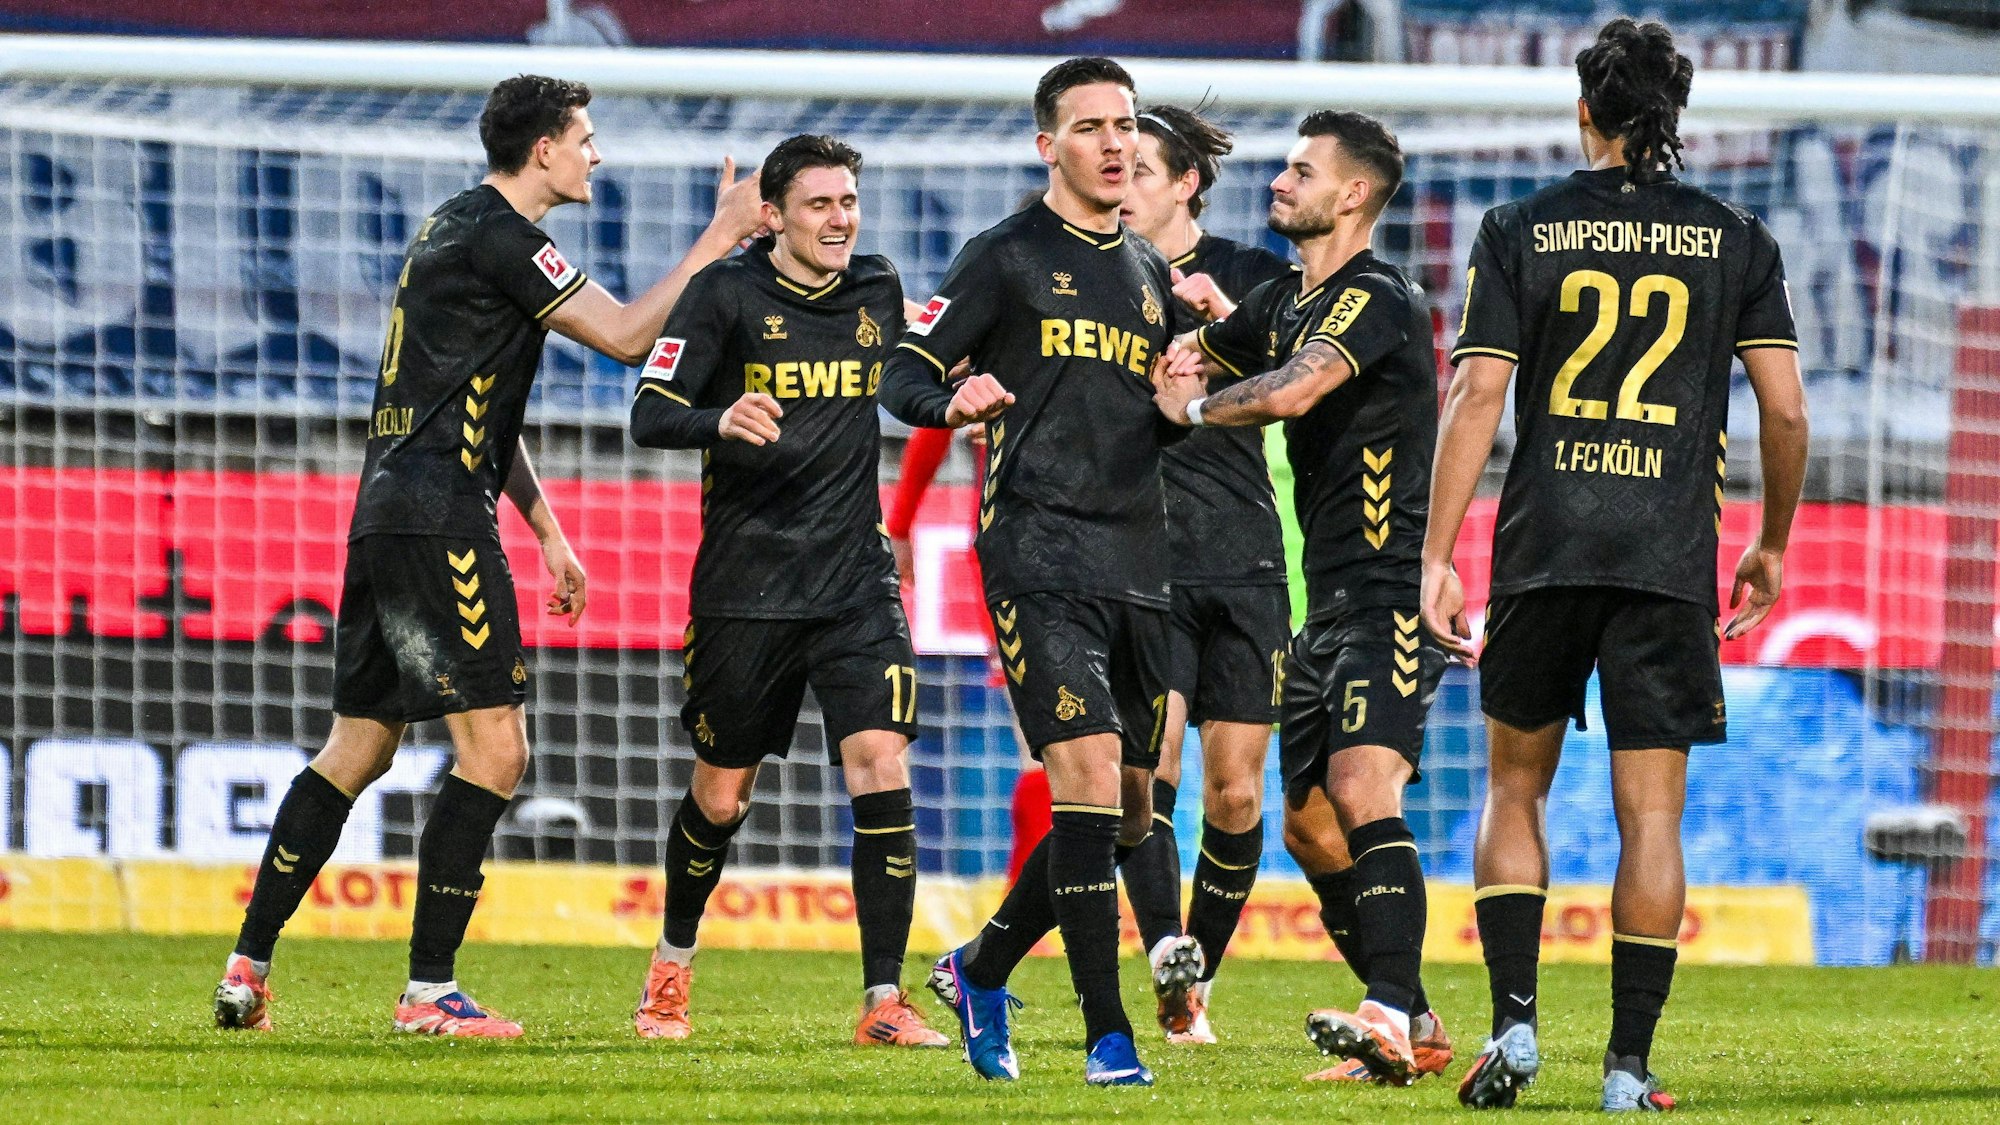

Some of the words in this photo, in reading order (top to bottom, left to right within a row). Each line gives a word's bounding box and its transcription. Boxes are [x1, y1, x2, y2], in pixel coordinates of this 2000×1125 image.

[1533, 220, 1723, 259] SIMPSON-PUSEY
[1041, 318, 1150, 376] REWE
[1549, 269, 1690, 427] 22
[744, 360, 863, 399] REWE
[1554, 440, 1567, 471] 1.
[1570, 442, 1599, 473] FC
[1601, 439, 1663, 479] KÖLN
[884, 664, 916, 724] 17
[1342, 679, 1371, 734] 5
[703, 881, 856, 922] OTTO
